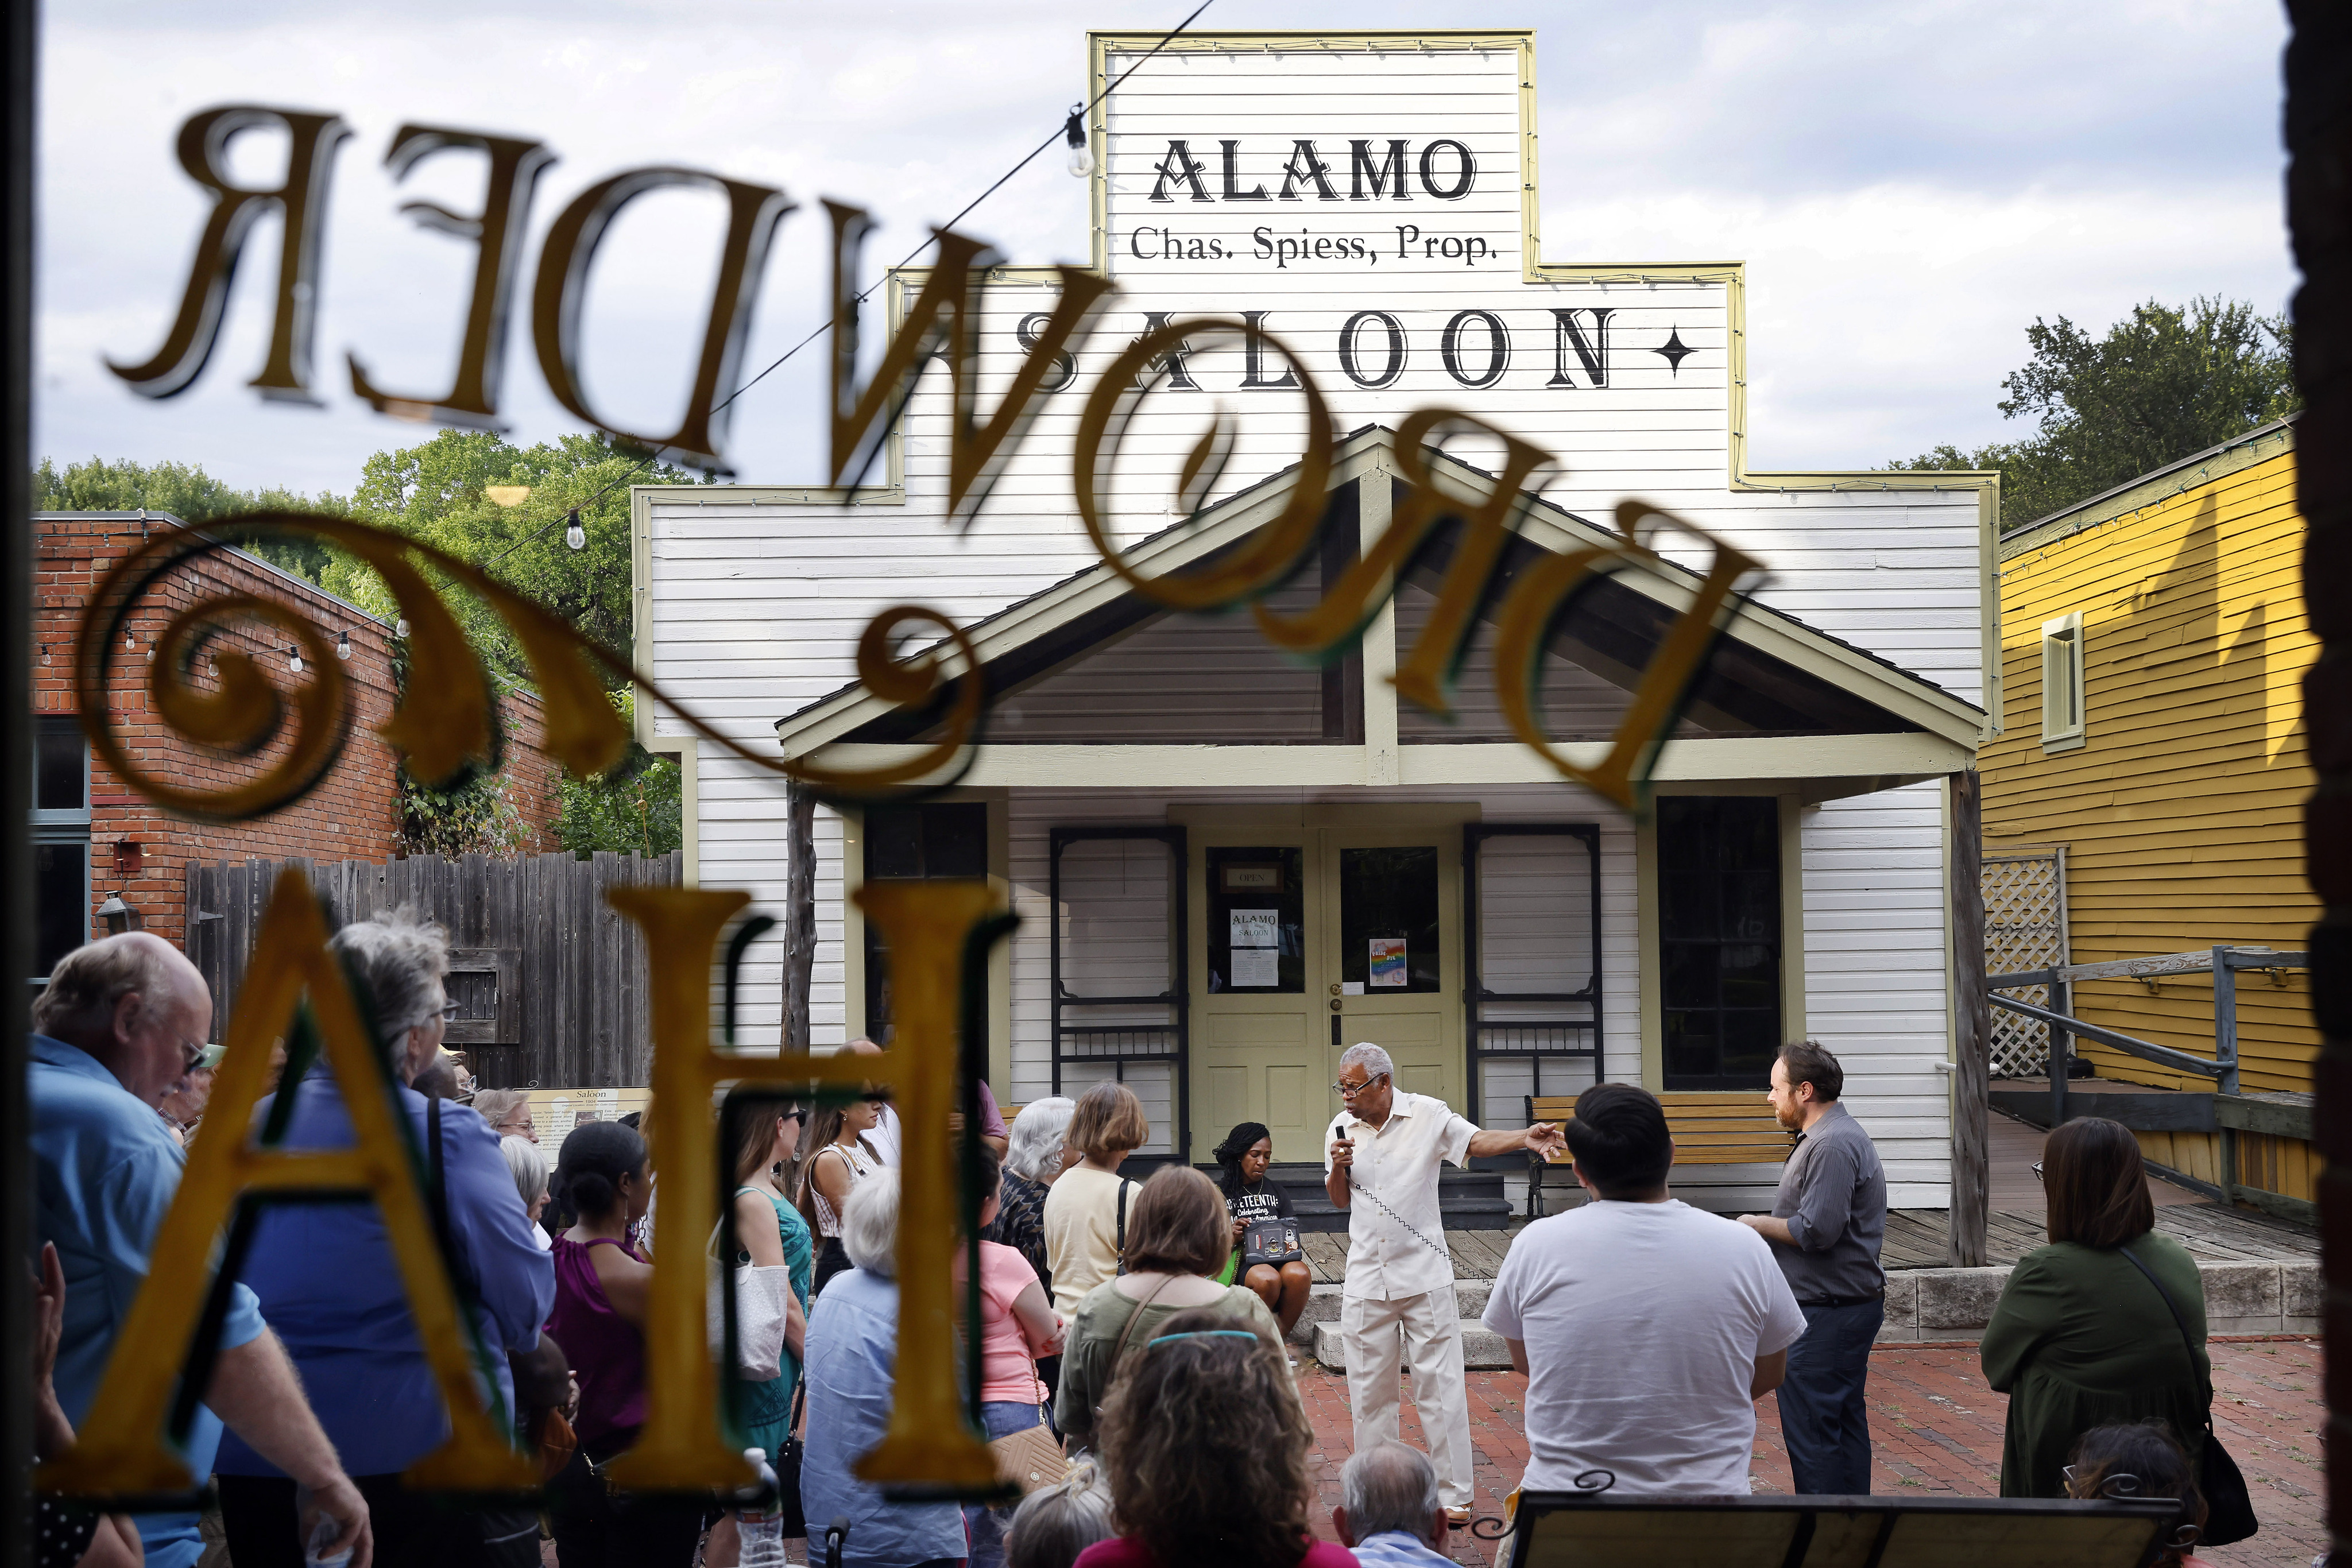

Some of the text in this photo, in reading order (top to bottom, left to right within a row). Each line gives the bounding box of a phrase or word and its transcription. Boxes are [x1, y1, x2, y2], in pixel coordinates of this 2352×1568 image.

[1148, 139, 1477, 202] ALAMO
[1131, 224, 1496, 268] Chas. Spiess, Prop.
[1016, 308, 1618, 392] SALOON
[1232, 915, 1275, 924] ALAMO
[1237, 1207, 1269, 1216] Celebrating
